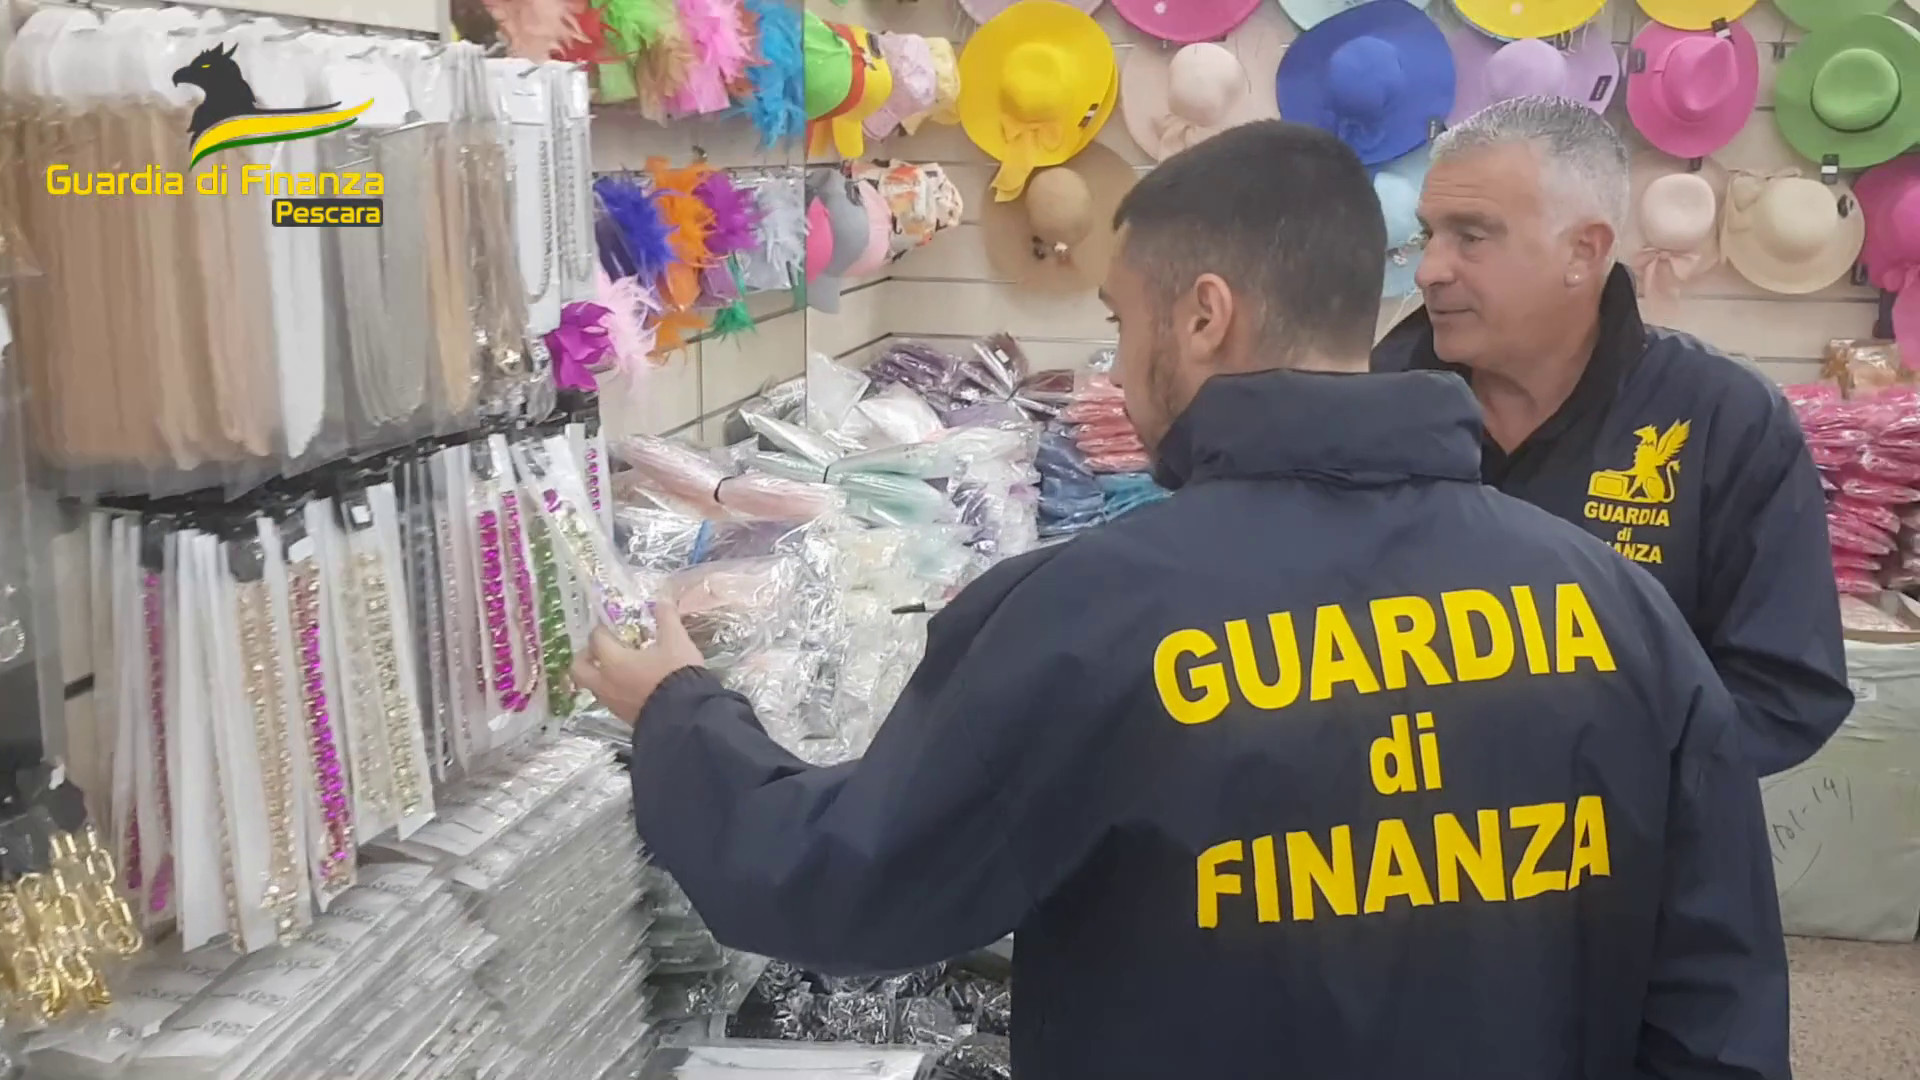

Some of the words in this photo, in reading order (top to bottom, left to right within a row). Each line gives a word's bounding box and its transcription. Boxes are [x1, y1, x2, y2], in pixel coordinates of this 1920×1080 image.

[1584, 501, 1671, 527] GUARDIA
[1616, 527, 1632, 541] di
[1613, 542, 1663, 564] ANZA
[1153, 583, 1617, 725] GUARDIA
[1369, 711, 1443, 796] di
[1197, 795, 1611, 929] FINANZA
